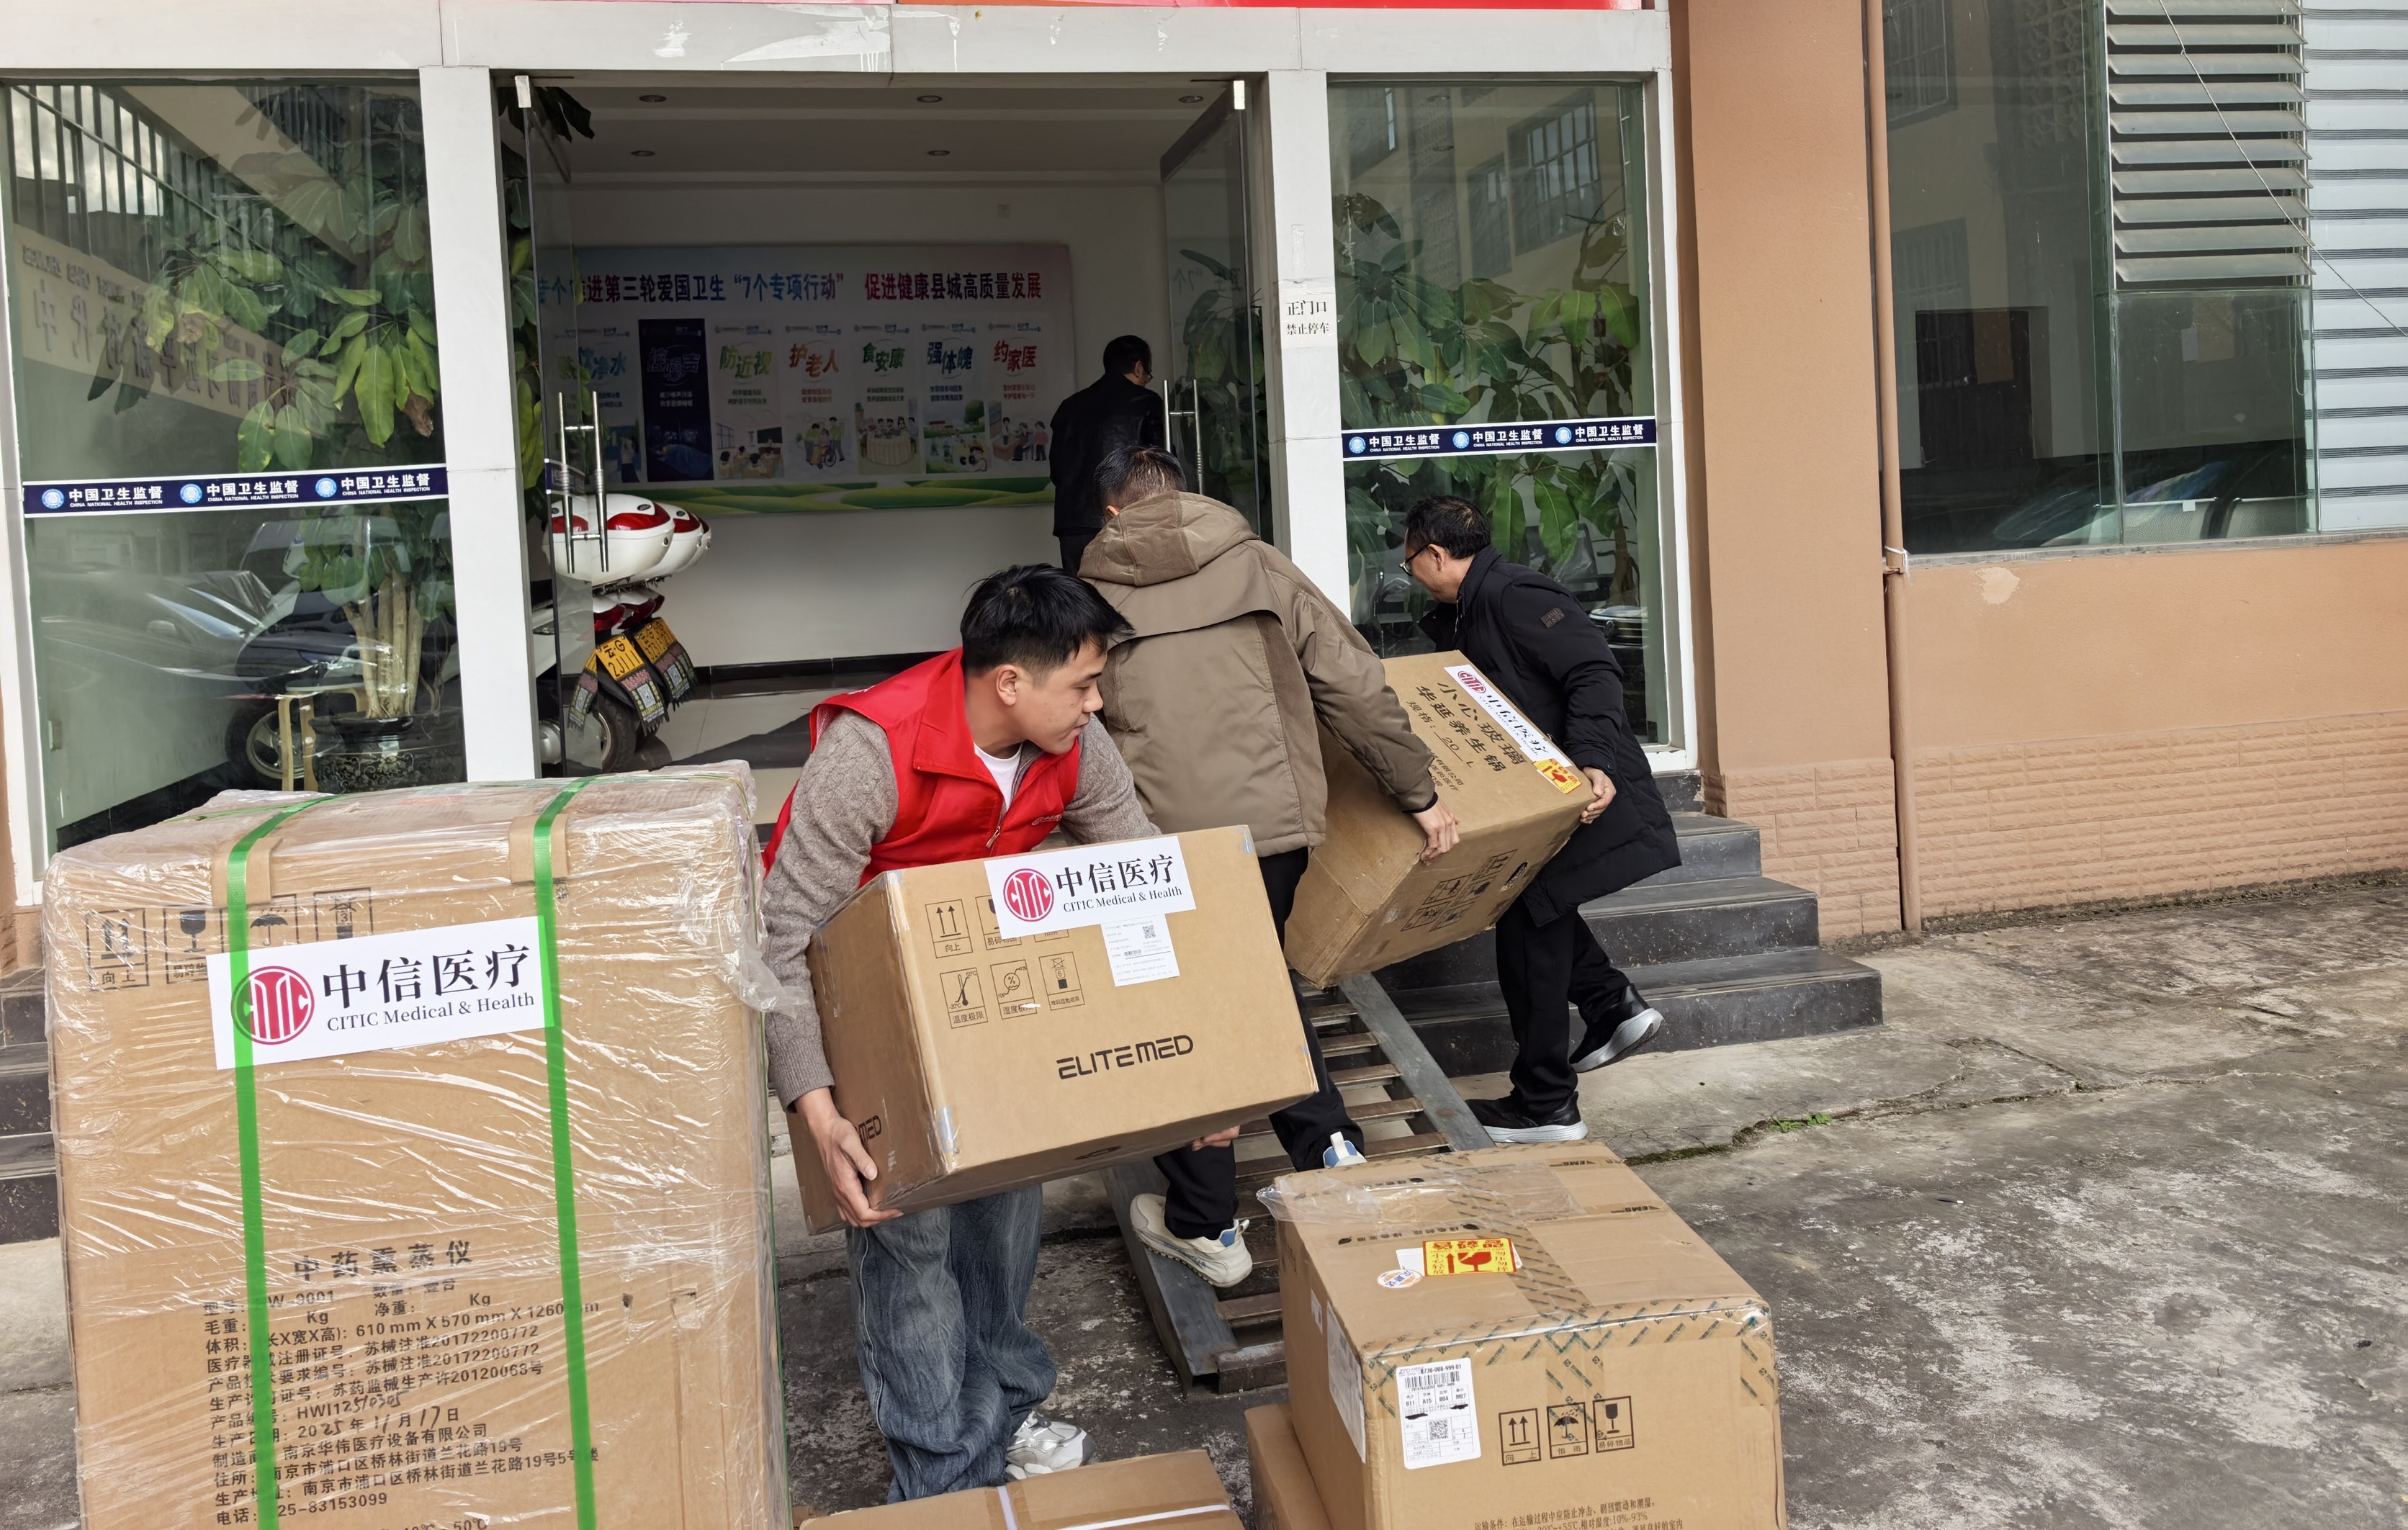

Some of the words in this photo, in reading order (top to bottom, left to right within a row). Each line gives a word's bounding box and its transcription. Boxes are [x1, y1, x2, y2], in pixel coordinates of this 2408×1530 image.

[582, 273, 843, 302] 进第三轮爱国卫生“7个专项行动”
[864, 272, 1042, 301] 促进健康县城高质量发展
[1286, 300, 1326, 315] 正门口
[1286, 323, 1329, 336] 禁止停车
[719, 345, 772, 378] 防近视
[790, 343, 839, 377] 护老人
[993, 340, 1037, 372] 约家医
[1369, 433, 1440, 447] 中国卫生监督
[1473, 428, 1542, 443] 中国卫生监督
[1575, 424, 1644, 438] 中国卫生监督
[69, 485, 163, 502] 中国卫生监督
[207, 480, 298, 497] 中国卫生监督
[341, 473, 430, 490] 中国卫生监督
[1416, 685, 1506, 772] 华延养生锅
[1437, 683, 1527, 764] 小心玻璃
[1486, 694, 1549, 754] 中信医疗
[1442, 737, 1460, 752] 20
[1432, 755, 1464, 785] 有限公司
[1056, 854, 1173, 898] 中信医疗
[1064, 899, 1094, 912] CITIC
[1096, 893, 1136, 907] Medical
[1138, 892, 1146, 901] &
[1149, 886, 1182, 900] Health
[340, 912, 349, 922] 3
[945, 943, 961, 953] 向上
[102, 970, 135, 986] 向上
[322, 943, 530, 1009] 中信医疗
[327, 1012, 378, 1032] CITIC
[383, 1002, 453, 1025] Medical
[458, 1000, 472, 1014] &
[477, 992, 535, 1013] Health
[953, 1010, 984, 1024] 温度极限
[1433, 1240, 1504, 1249] 易碎品
[294, 1240, 473, 1282] 中药熏蒸仪
[374, 1300, 415, 1317] 净重：
[470, 1292, 491, 1307] Kg
[205, 1318, 246, 1336] 毛重：
[307, 1310, 329, 1325] Kg
[206, 1338, 247, 1357] 体积：
[356, 1322, 385, 1337] 610
[390, 1321, 421, 1333] mm
[426, 1316, 437, 1330] X
[441, 1314, 470, 1328] 570
[475, 1312, 506, 1325] mm
[511, 1307, 522, 1320] X
[528, 1303, 564, 1318] 1260
[298, 1419, 344, 1439] 2025
[351, 1418, 364, 1432] 年
[398, 1413, 412, 1428] 月
[420, 1405, 441, 1428] 17
[447, 1408, 459, 1423] 日
[284, 1423, 488, 1461] 南京华伟医疗设备有限公司
[1599, 1439, 1632, 1449] 易碎物品
[214, 1470, 255, 1488] 住所：
[217, 1508, 257, 1526] 电话：
